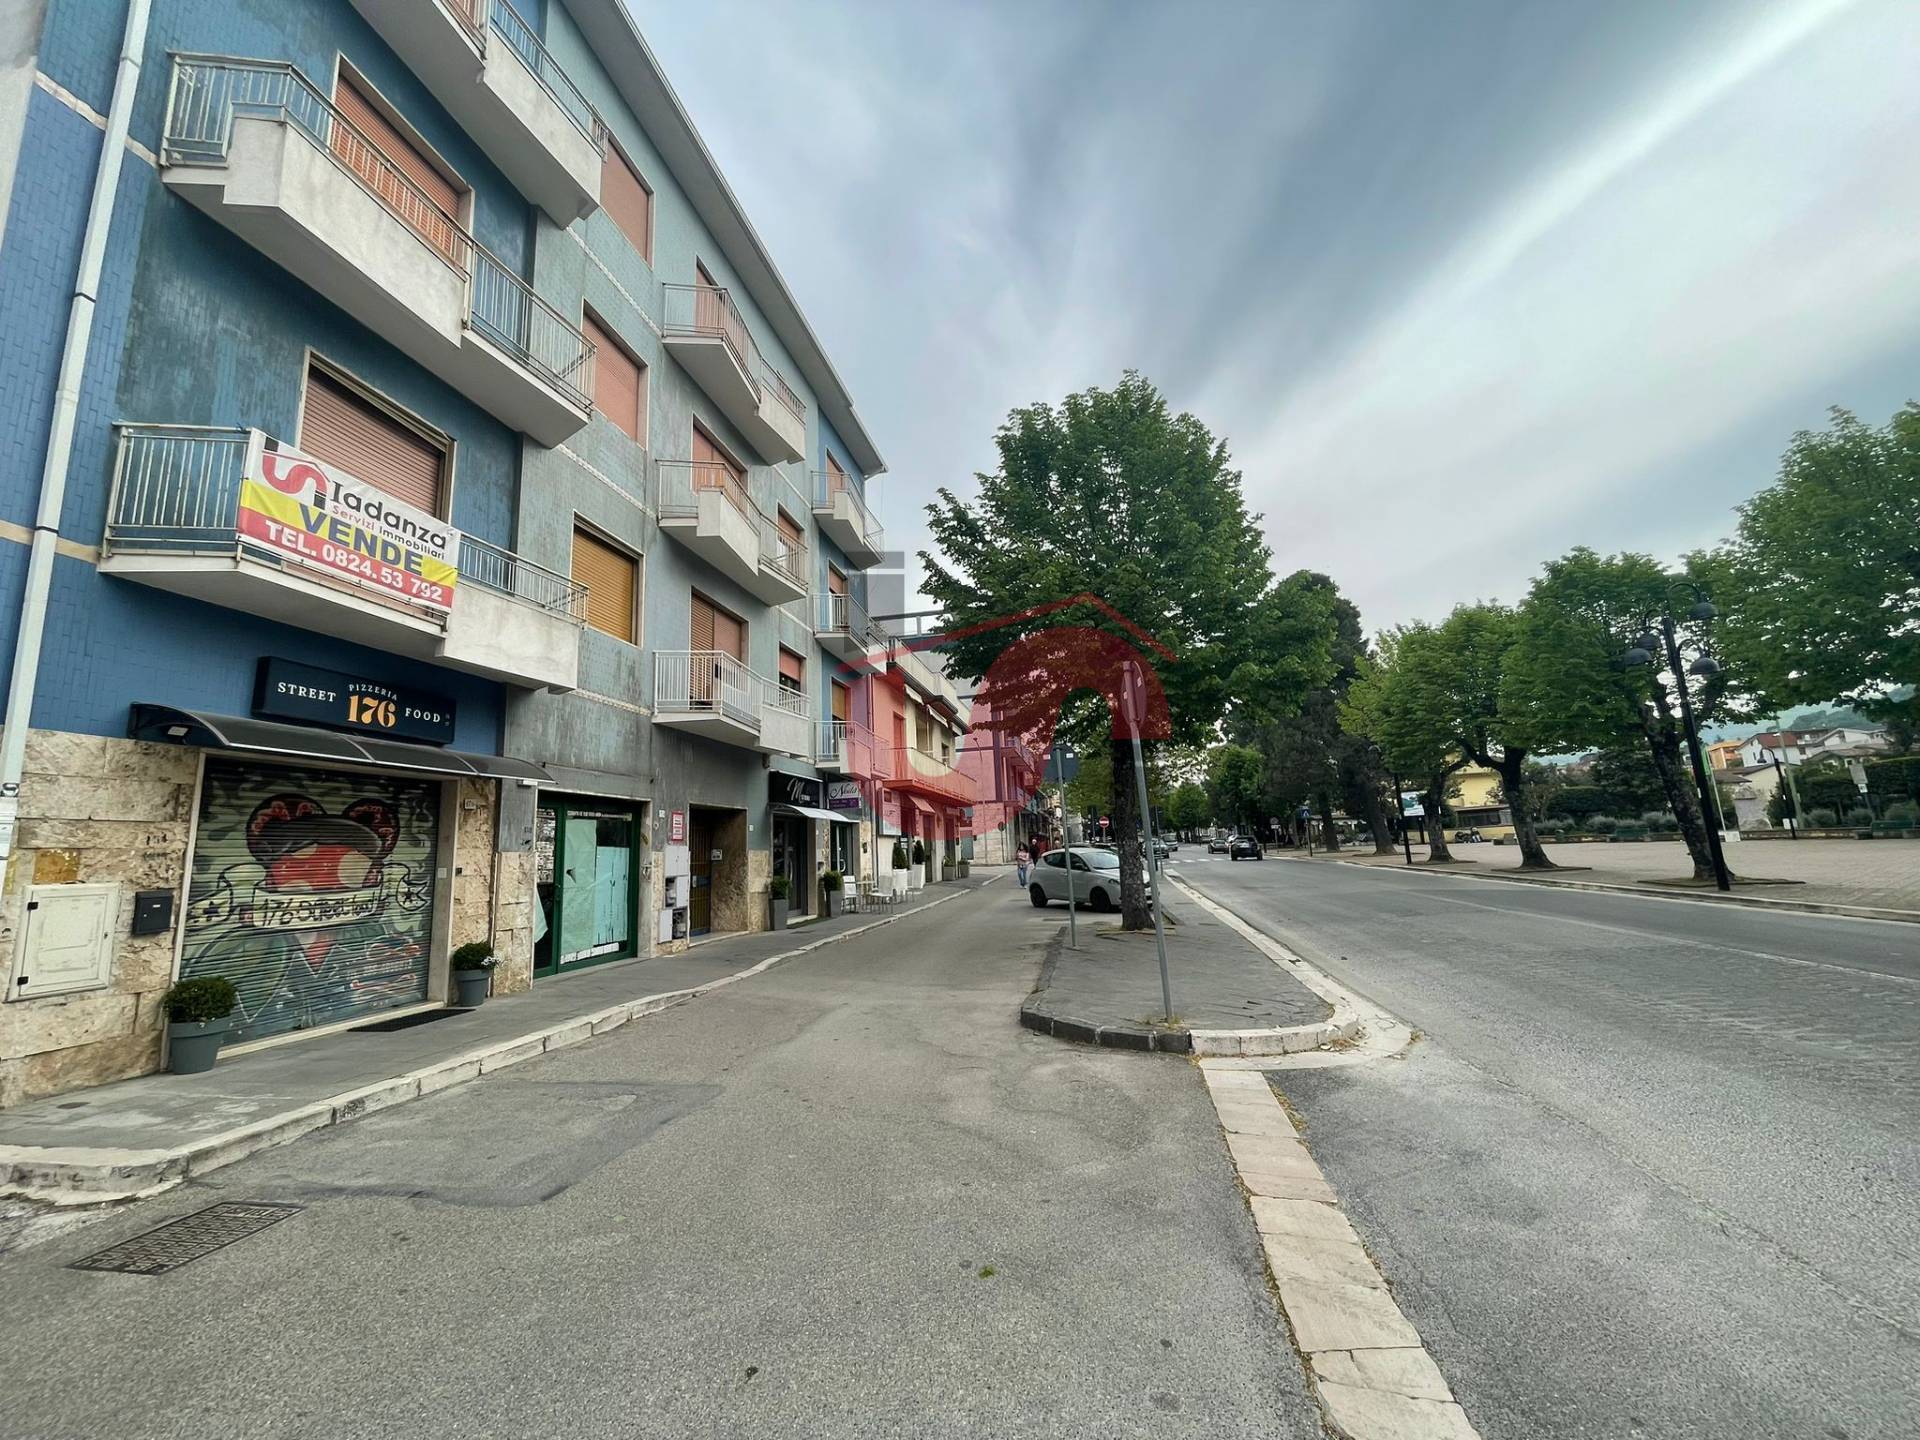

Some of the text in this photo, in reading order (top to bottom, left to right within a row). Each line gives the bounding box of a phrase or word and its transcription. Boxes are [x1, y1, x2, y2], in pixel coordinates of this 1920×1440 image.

[332, 505, 375, 531] Servizi
[333, 480, 447, 550] Iadanza
[299, 502, 424, 576] VENDE
[265, 520, 317, 555] TEL.
[409, 577, 443, 601] 792
[277, 682, 337, 702] STREET
[348, 683, 398, 701] PIZZERIA
[347, 694, 397, 728] 176
[404, 707, 441, 723] FOOD
